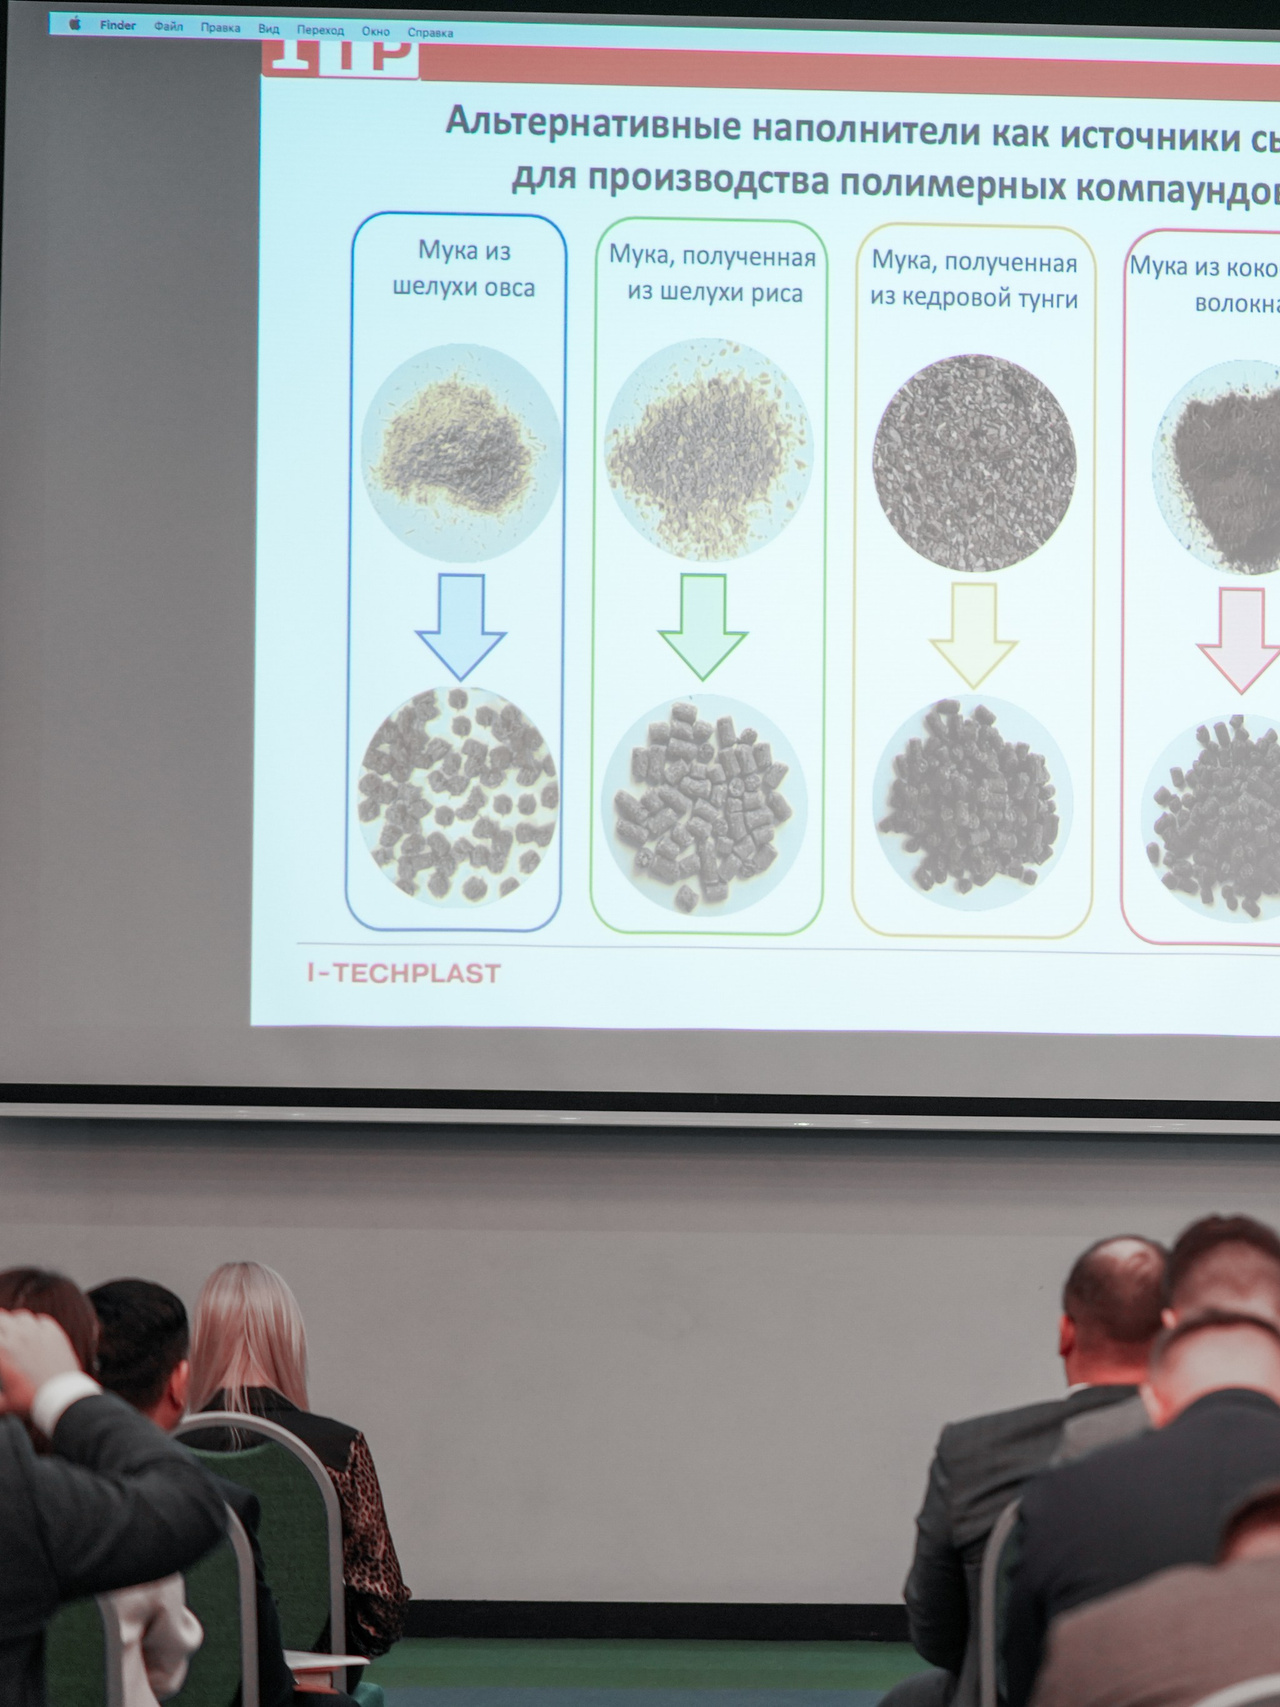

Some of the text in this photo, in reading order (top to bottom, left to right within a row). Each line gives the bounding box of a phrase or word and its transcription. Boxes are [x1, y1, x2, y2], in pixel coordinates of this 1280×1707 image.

[101, 19, 136, 31] Finder
[154, 20, 184, 32] Файл
[200, 21, 241, 34] Правка
[258, 23, 281, 35] Вид
[297, 24, 345, 37] Переход
[361, 25, 391, 37] Окно
[407, 26, 454, 40] Справка
[445, 103, 742, 144] Альтернативные
[753, 117, 980, 146] наполнители
[992, 122, 1050, 148] как
[1061, 124, 1241, 153] источники
[511, 164, 577, 196] для
[588, 166, 830, 200] производства
[840, 172, 1067, 206] полимерных
[418, 238, 511, 265] Мука из
[609, 242, 817, 272] Мука, полученная
[872, 248, 1078, 277] Мука, полученная
[1130, 254, 1189, 282] Мука
[1195, 260, 1221, 277] из
[393, 279, 536, 301] шелухи овса
[628, 283, 804, 307] из шелухи риса
[871, 285, 1079, 314] из кедровой тунги
[307, 961, 503, 984] I-TECHPLAST
